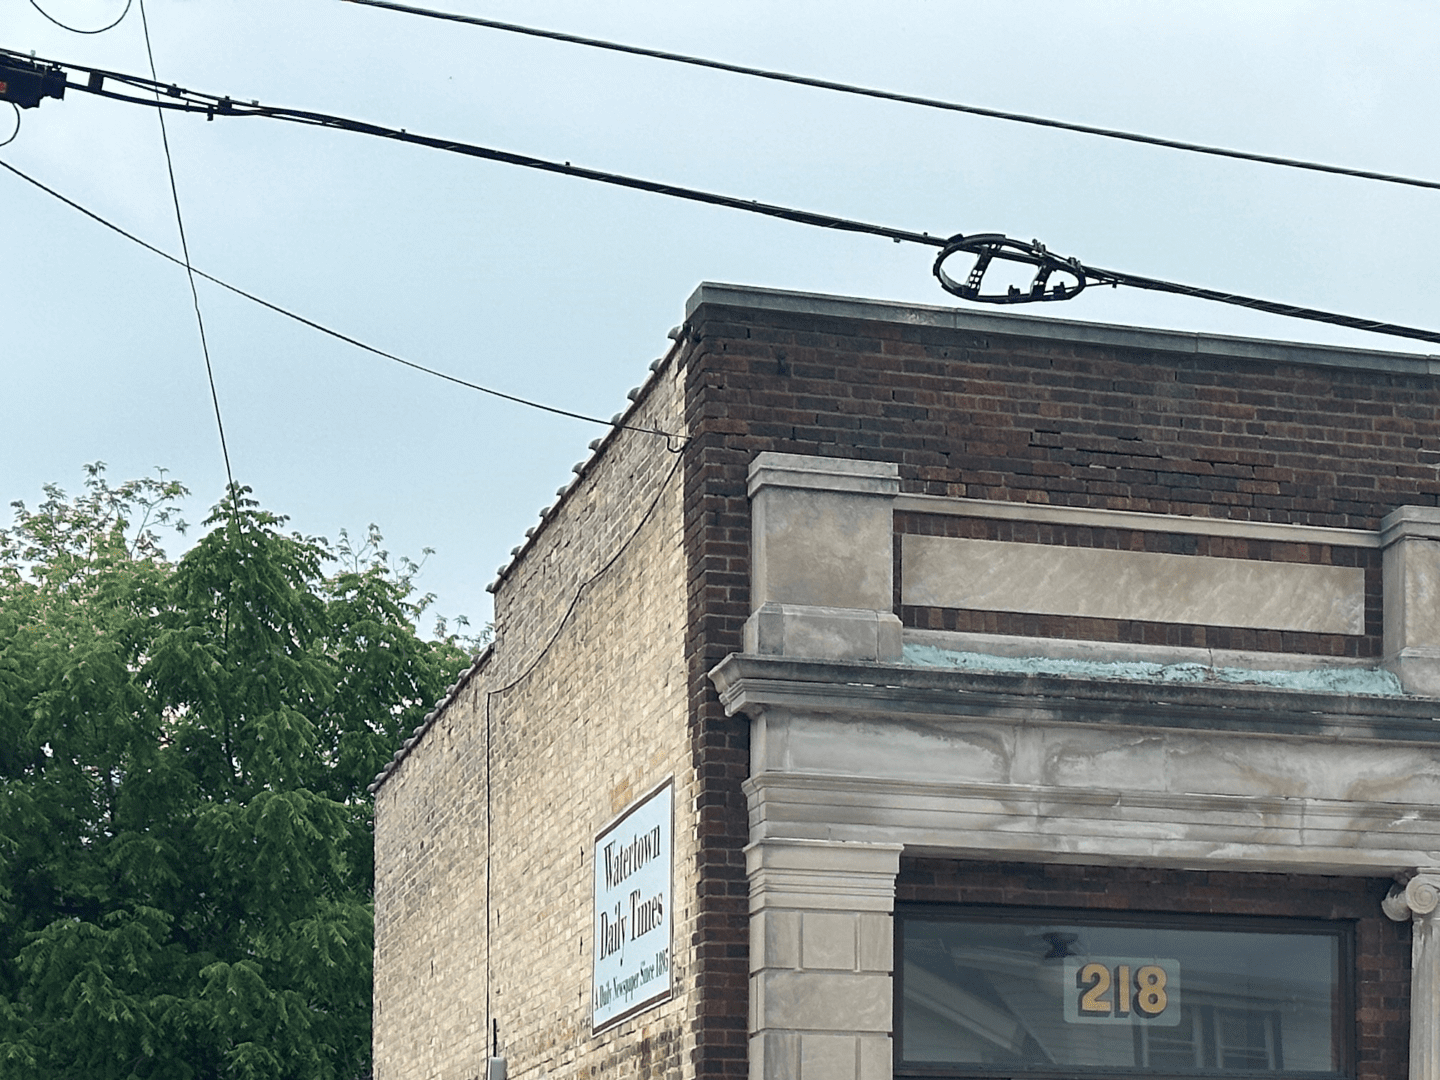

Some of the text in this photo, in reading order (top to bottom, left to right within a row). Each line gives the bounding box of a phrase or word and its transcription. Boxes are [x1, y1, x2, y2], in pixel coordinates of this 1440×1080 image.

[604, 825, 660, 893] Watertown
[600, 888, 663, 967] Daily Times
[600, 980, 612, 1012] Daily
[613, 972, 640, 1003] Newspaper
[640, 960, 655, 986] Since
[1077, 962, 1168, 1018] 218
